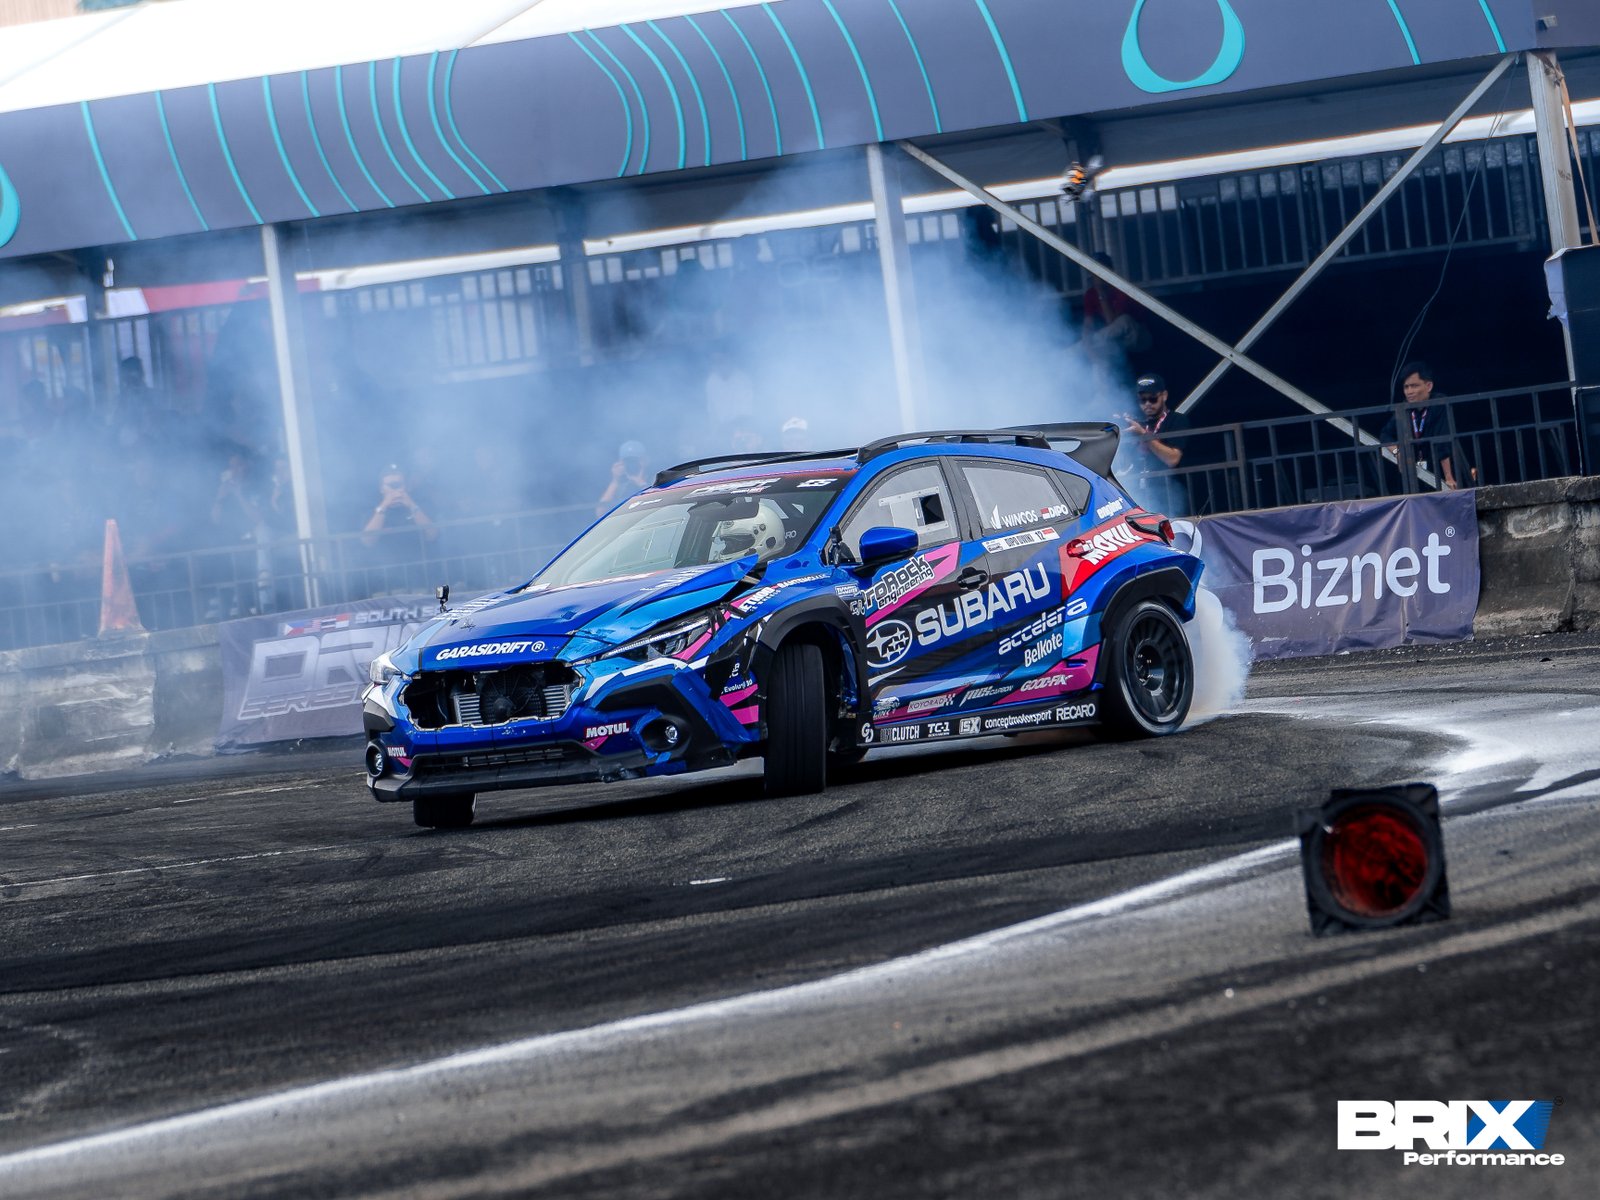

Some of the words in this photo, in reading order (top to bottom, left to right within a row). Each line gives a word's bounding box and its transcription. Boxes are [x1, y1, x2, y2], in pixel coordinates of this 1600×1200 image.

[1001, 510, 1039, 528] WINCOS
[1048, 505, 1069, 518] DIPO
[1083, 522, 1144, 565] MOTUL
[878, 567, 935, 610] engineering
[915, 562, 1051, 646] SUBARU
[998, 598, 1088, 655] accelera
[436, 641, 533, 661] GARASIDRIFT
[985, 710, 1052, 729] conceptmotorsport
[1056, 703, 1096, 721] RECARO
[586, 722, 630, 738] MOTUL
[387, 747, 407, 758] MOTUL
